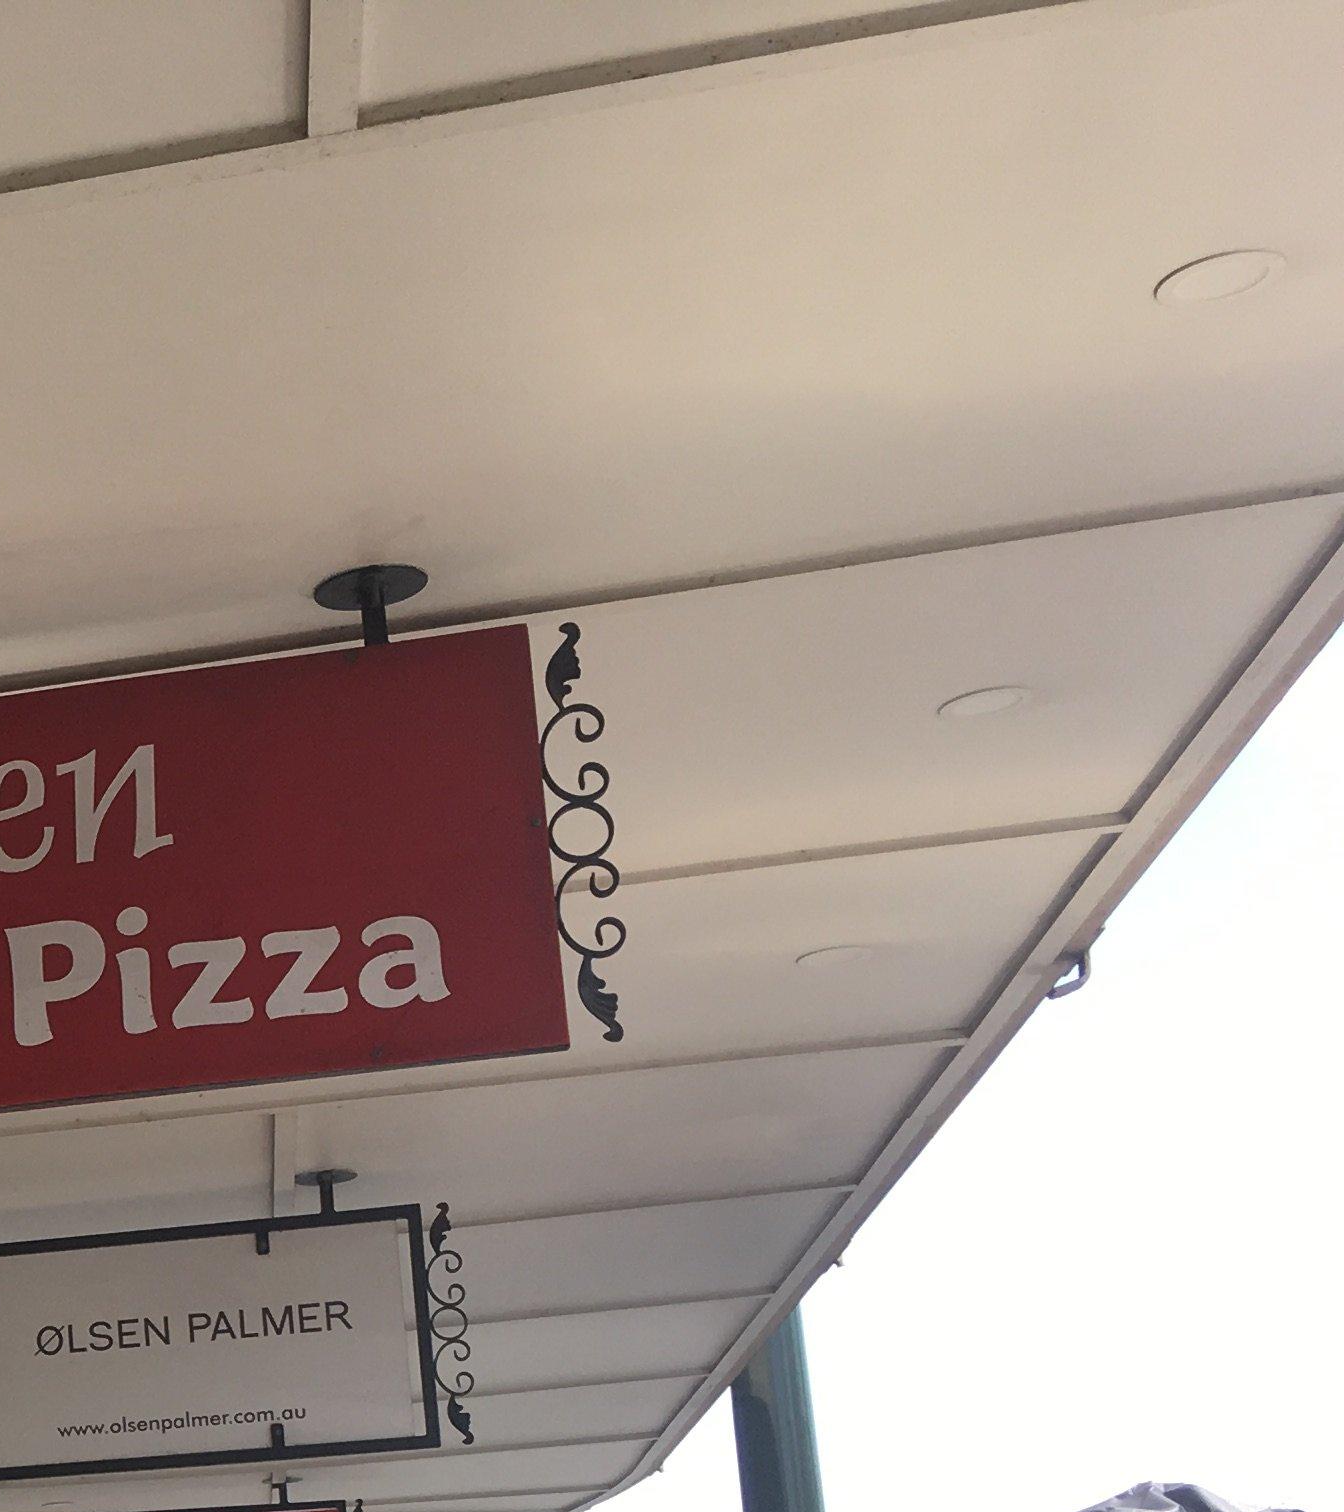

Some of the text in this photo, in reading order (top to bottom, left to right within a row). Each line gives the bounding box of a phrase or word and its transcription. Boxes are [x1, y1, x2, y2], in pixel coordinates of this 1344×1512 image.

[4, 907, 450, 1046] Pizza
[188, 1301, 352, 1342] PALMER
[57, 1407, 306, 1438] www.olsenpalmer.com.au
